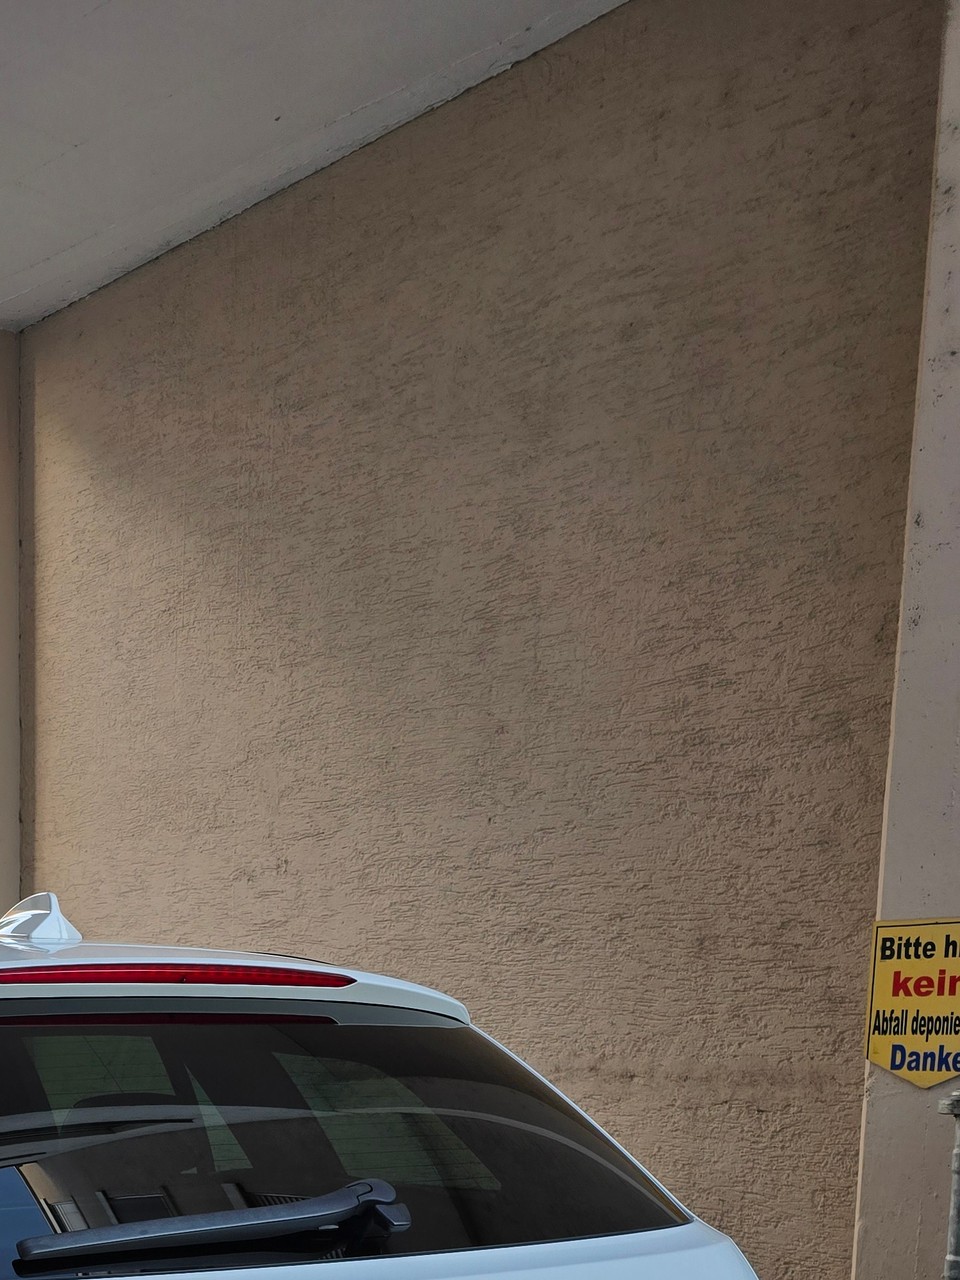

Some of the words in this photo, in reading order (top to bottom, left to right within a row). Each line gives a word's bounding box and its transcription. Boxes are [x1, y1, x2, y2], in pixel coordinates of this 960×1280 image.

[880, 936, 936, 961] Bitte
[944, 934, 960, 958] h
[872, 1009, 908, 1036] Abfall
[890, 1044, 960, 1072] Danke
